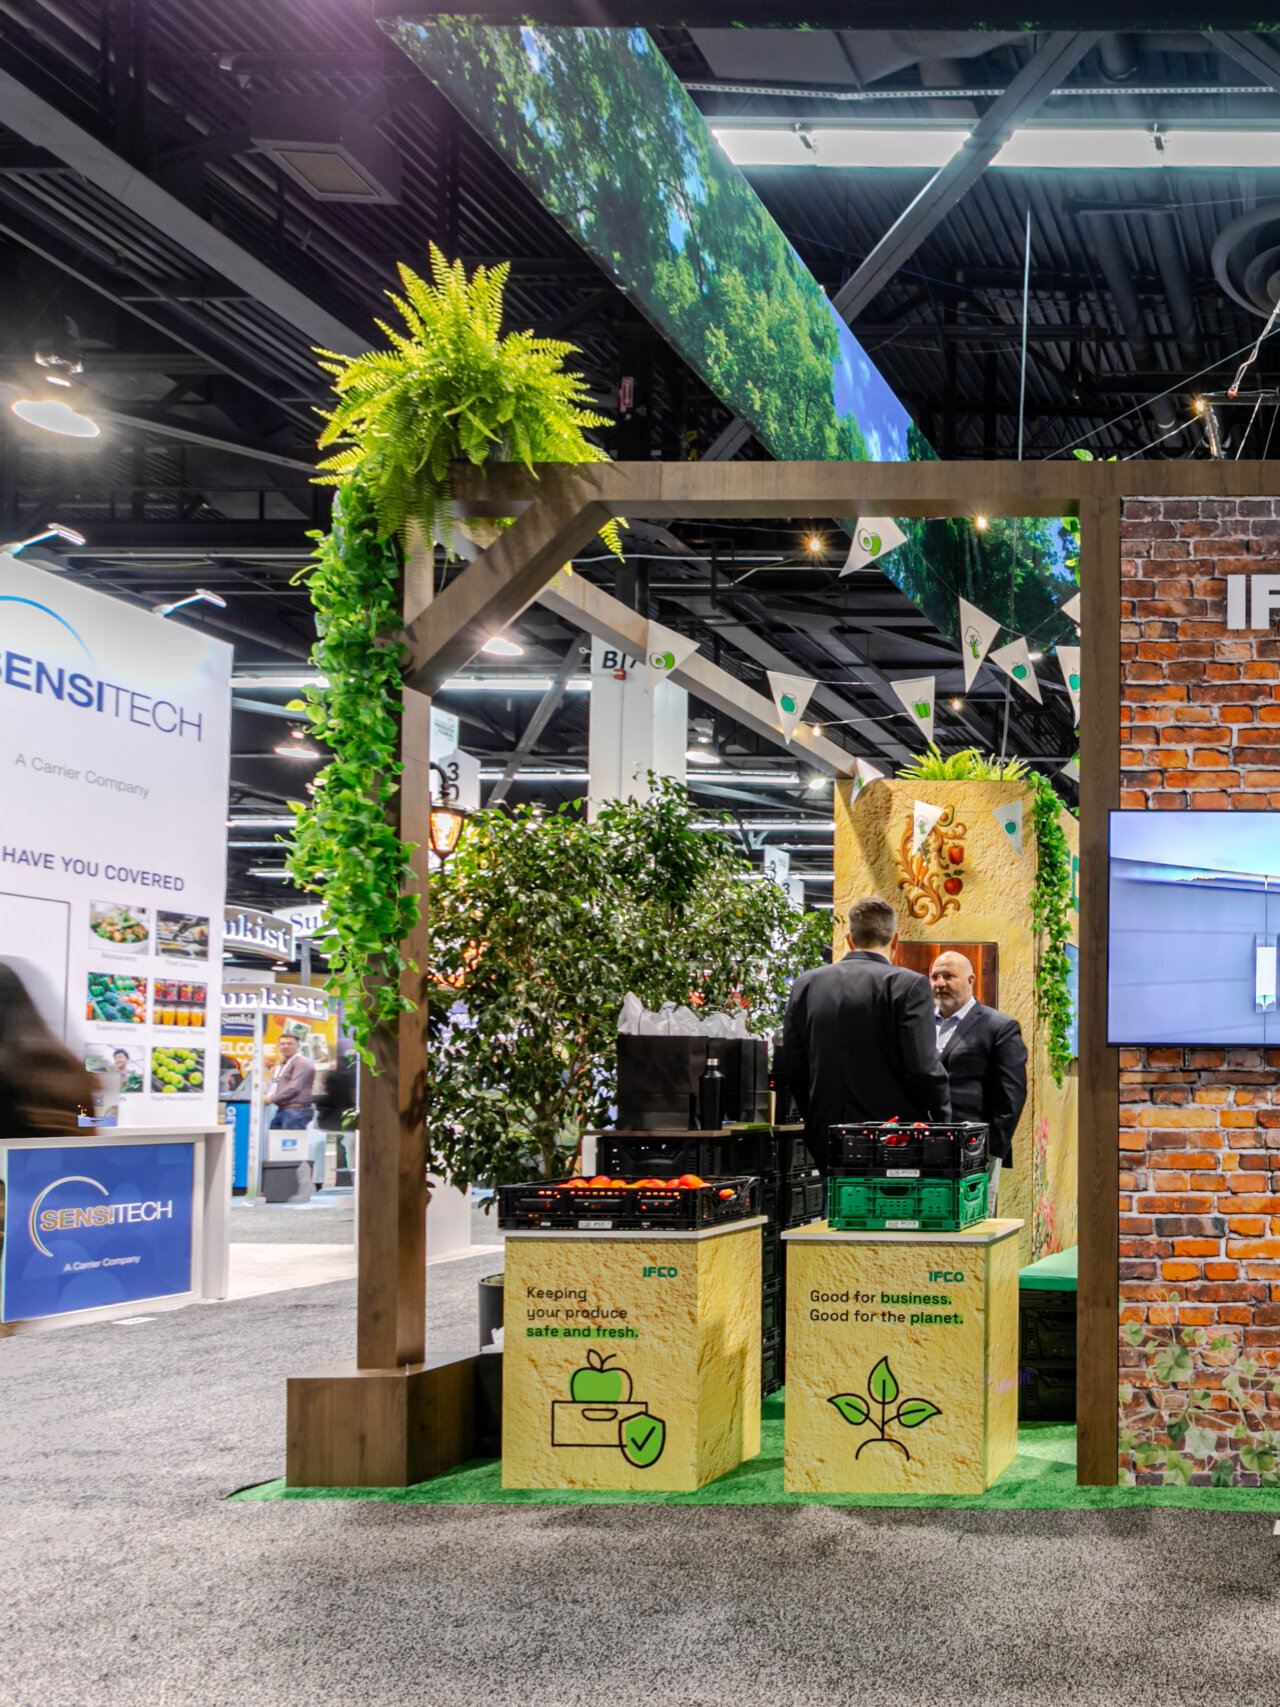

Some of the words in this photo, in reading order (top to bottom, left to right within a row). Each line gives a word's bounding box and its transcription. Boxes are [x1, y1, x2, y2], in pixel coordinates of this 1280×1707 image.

[0, 649, 202, 742] ENSITECH
[15, 753, 27, 767] A
[32, 756, 81, 780] Carrier
[85, 770, 150, 799] Company
[2, 846, 55, 870] HAVE
[61, 856, 100, 877] YOU
[104, 864, 185, 892] COVERED
[222, 913, 291, 953] nkist
[40, 1200, 173, 1231] SENSITECH
[63, 1263, 71, 1272] A
[72, 1260, 101, 1271] Carrier
[102, 1255, 141, 1268] Company
[643, 1266, 678, 1278] IFCO
[929, 1271, 965, 1283] IFCO
[526, 1286, 587, 1302] Keeping
[810, 1290, 849, 1303] Good
[854, 1290, 877, 1304] for
[880, 1291, 952, 1305] business.
[526, 1308, 561, 1320] your
[565, 1307, 628, 1320] produce
[810, 1309, 849, 1322] Good
[854, 1309, 877, 1322] for
[881, 1310, 906, 1323] the
[910, 1311, 964, 1326] planet.
[526, 1326, 559, 1338] safe
[563, 1326, 591, 1338] and
[596, 1326, 639, 1338] fresh.
